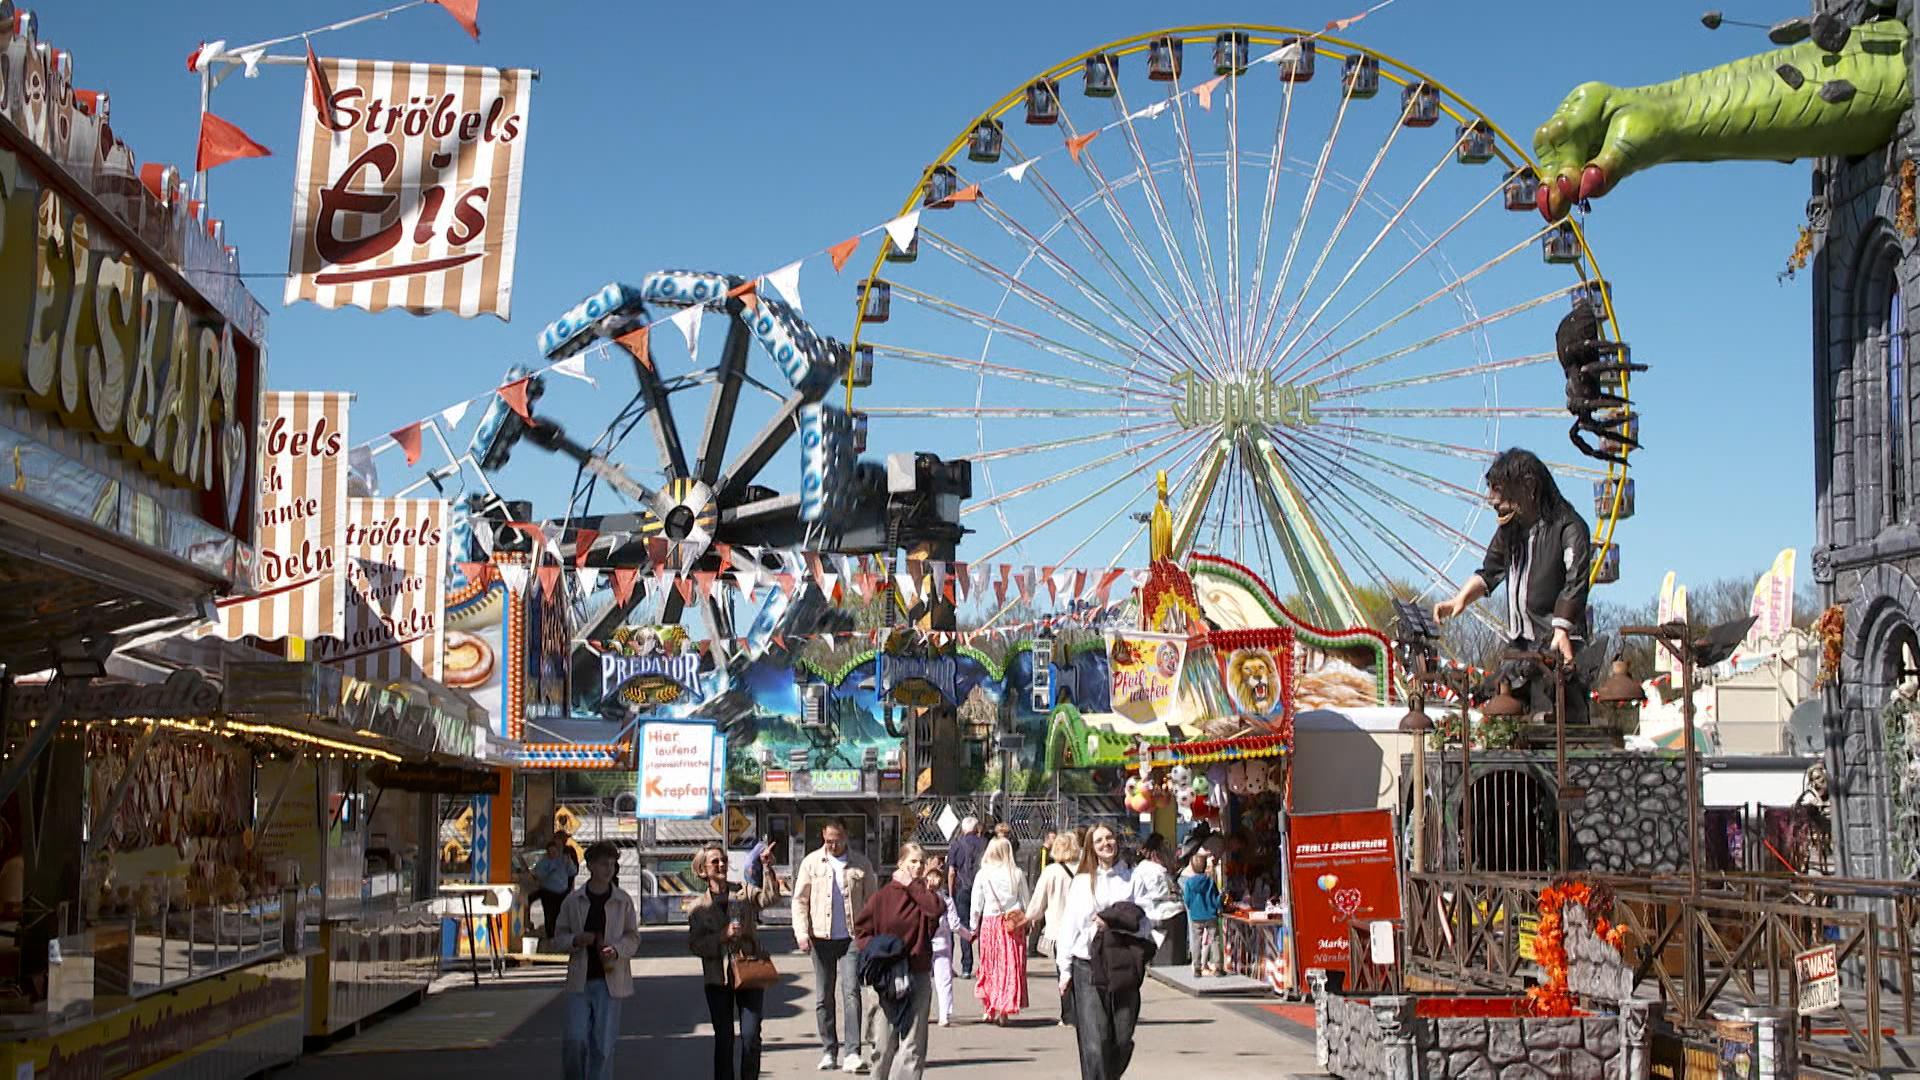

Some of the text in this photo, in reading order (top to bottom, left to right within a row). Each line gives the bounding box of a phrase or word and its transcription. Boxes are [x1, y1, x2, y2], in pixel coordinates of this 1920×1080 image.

[317, 87, 521, 143] Ströbels
[315, 142, 490, 265] Eis
[1169, 367, 1320, 439] Jupiter
[261, 416, 342, 457] bels
[345, 516, 441, 546] tröbels
[262, 539, 334, 583] deln
[601, 652, 702, 697] PREDATOR
[648, 730, 680, 742] Hier
[655, 745, 698, 756] laufend
[645, 775, 707, 799] Krapfen
[1797, 951, 1836, 982] BEWARE
